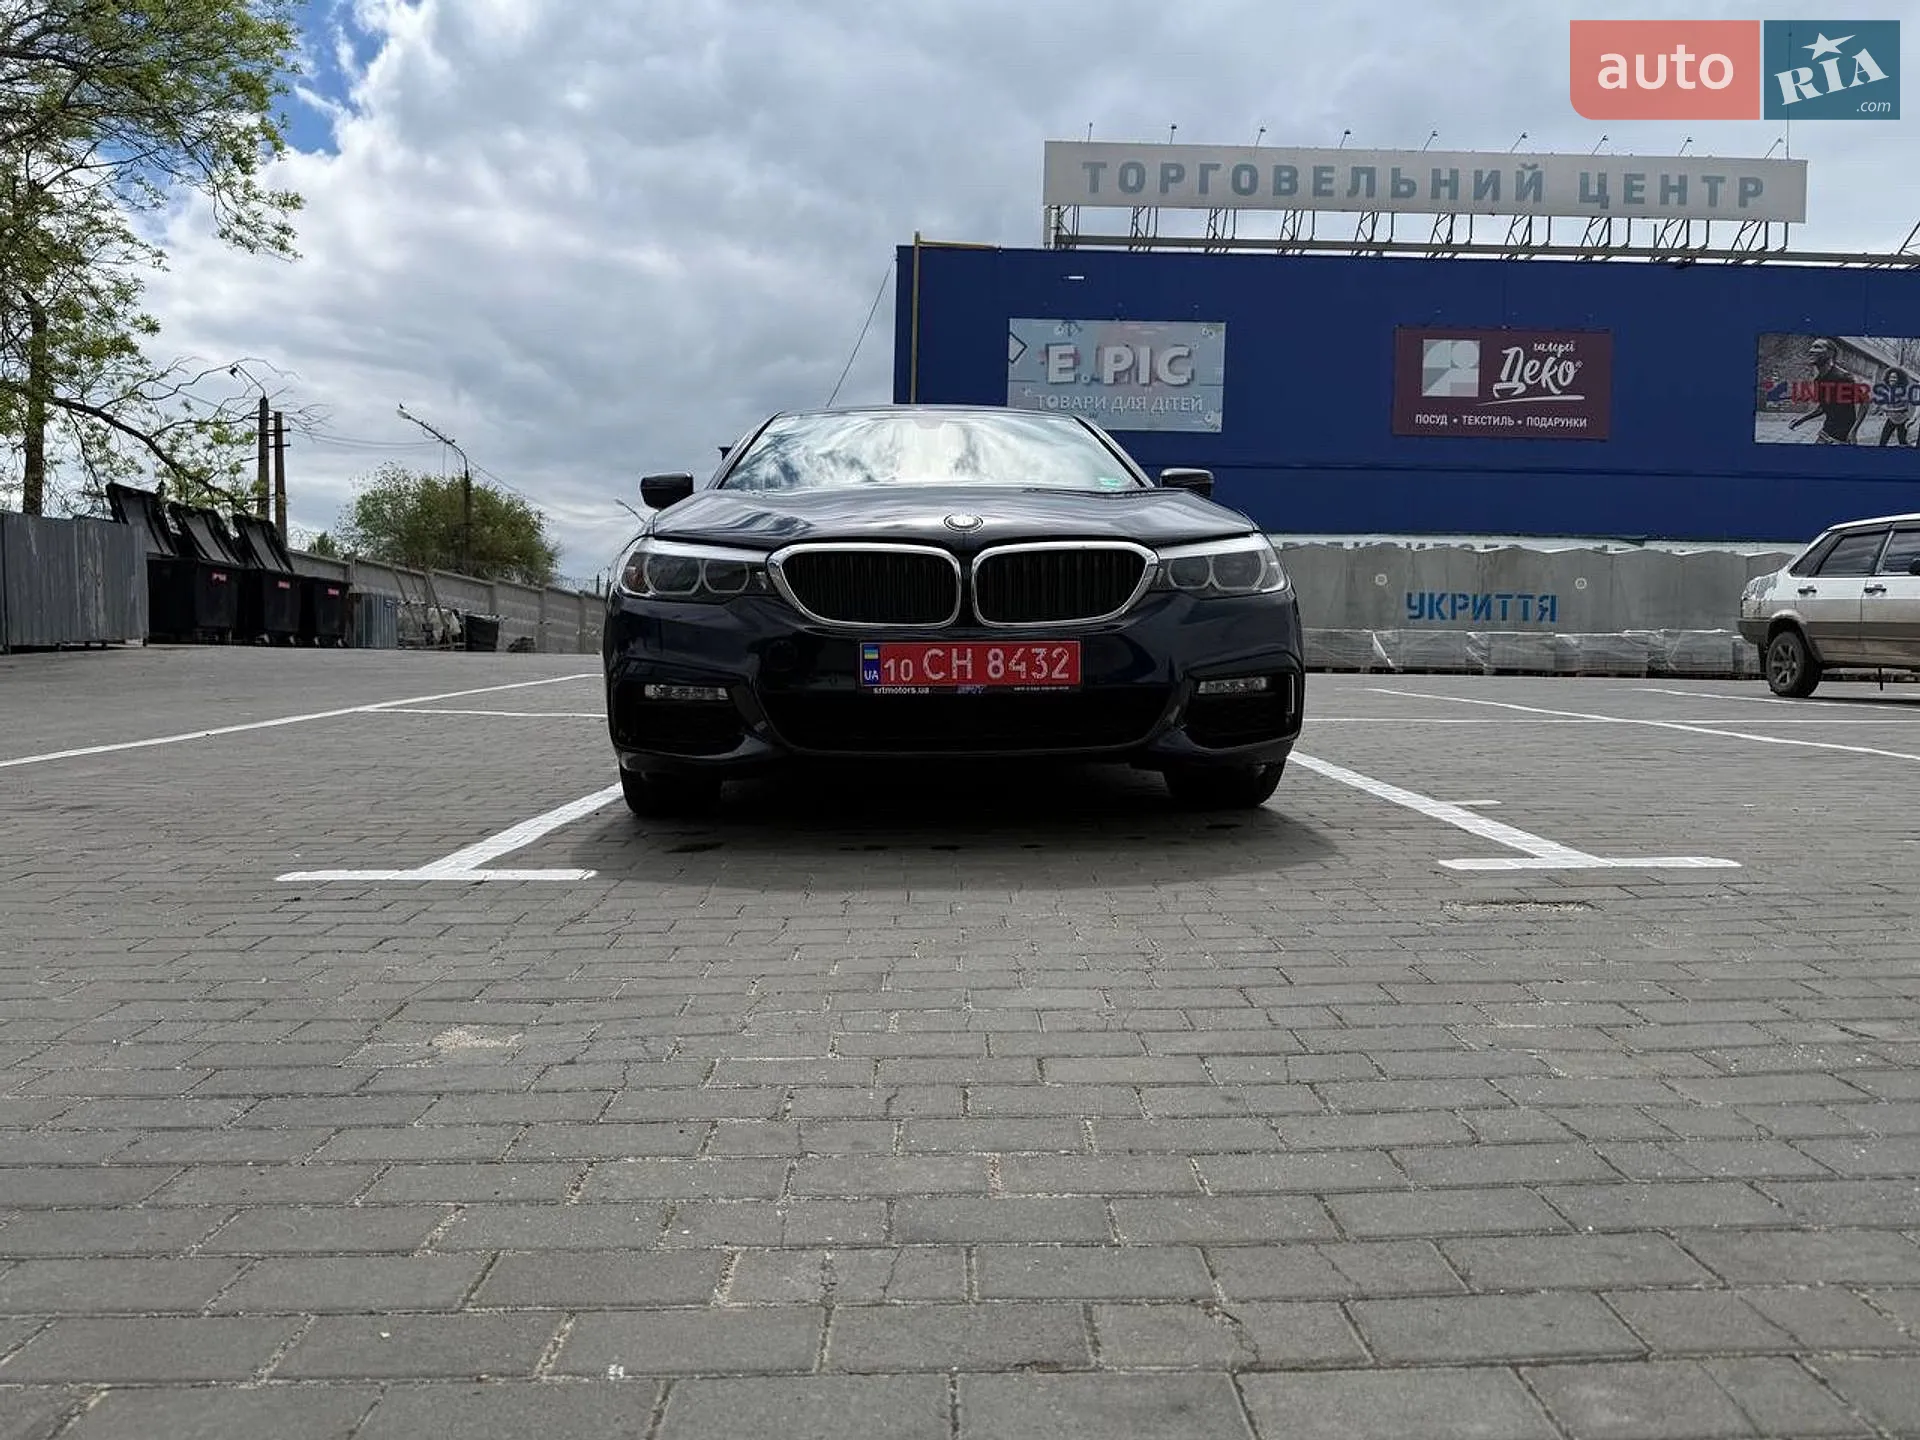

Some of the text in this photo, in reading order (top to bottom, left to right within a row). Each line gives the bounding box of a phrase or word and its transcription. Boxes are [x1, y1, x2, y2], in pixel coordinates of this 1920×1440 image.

[1082, 161, 1764, 210] ТОРГОВЕЛЬНИЙ ЦЕНТР
[1493, 347, 1577, 398] Деко
[1036, 395, 1203, 414] ТОВАРИ ДЛЯ ДІТЕЙ
[1415, 414, 1587, 429] ПОСУД ТЕКСТИЛЬ ПОДАРУНКИ
[1406, 591, 1557, 622] УКРИТТЯ
[864, 670, 879, 681] UA
[884, 648, 1070, 681] 10 CH 8432
